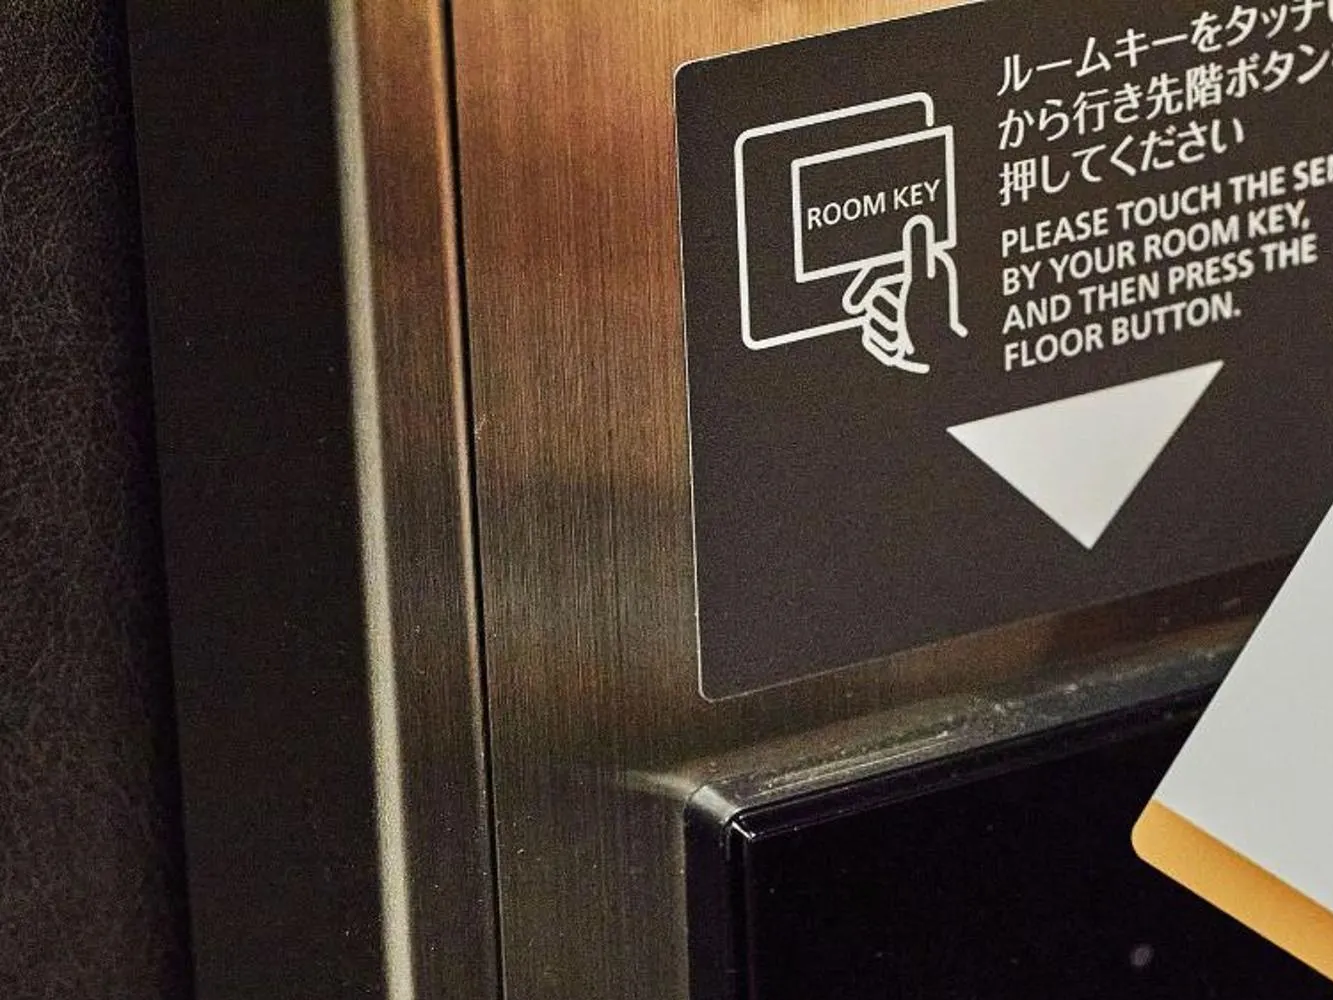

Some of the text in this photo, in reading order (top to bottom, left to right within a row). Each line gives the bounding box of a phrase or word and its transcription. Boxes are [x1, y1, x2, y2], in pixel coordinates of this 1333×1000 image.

[807, 179, 941, 230] ROOM KEY
[999, 118, 1244, 206] 押してください
[1002, 208, 1108, 258] PLEASE
[1116, 182, 1221, 230] TOUCH
[1229, 166, 1286, 204] THE
[1002, 233, 1318, 334] AND THEN PRESS THE
[1003, 265, 1041, 296] BY
[1049, 240, 1135, 284] YOUR
[1144, 214, 1239, 263] ROOM
[1004, 293, 1241, 371] FLOOR BUTTON.
